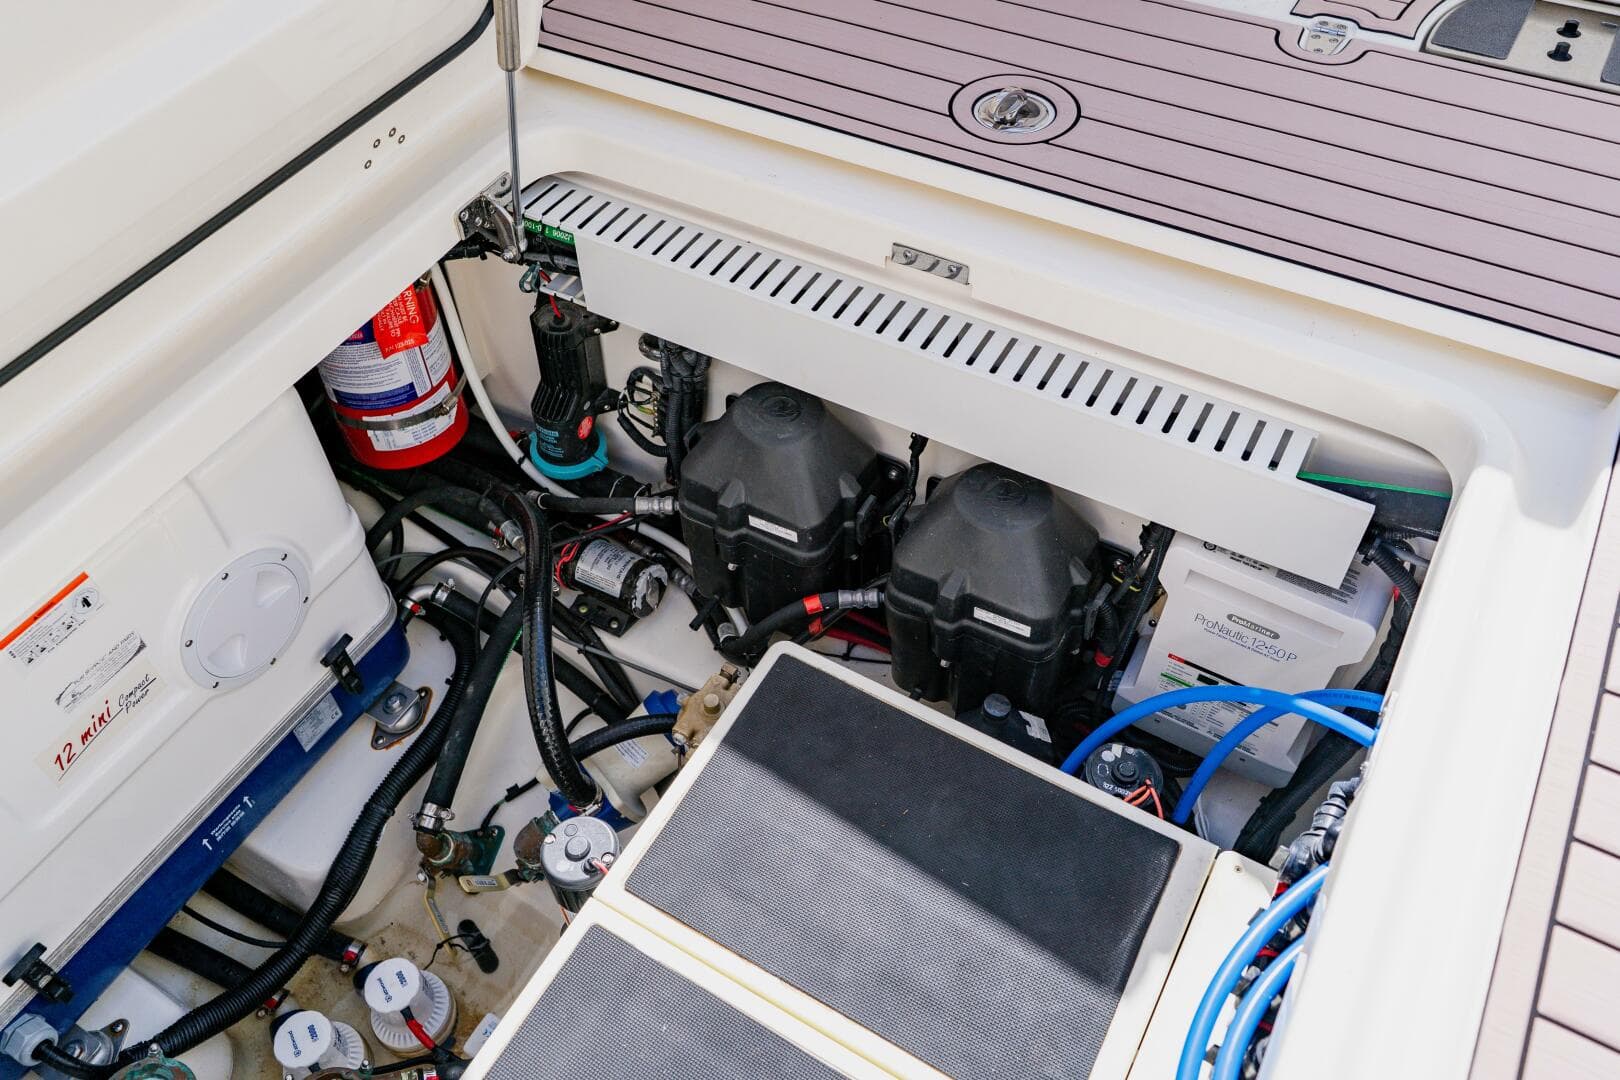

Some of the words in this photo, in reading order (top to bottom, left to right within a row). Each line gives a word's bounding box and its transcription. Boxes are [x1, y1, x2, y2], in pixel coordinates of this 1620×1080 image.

[403, 290, 419, 324] RNING
[1194, 613, 1249, 644] ProNautic
[1231, 615, 1275, 638] ProMariner
[118, 673, 150, 707] Compact
[125, 688, 149, 714] Power
[54, 742, 76, 771] 12
[80, 699, 111, 746] mini
